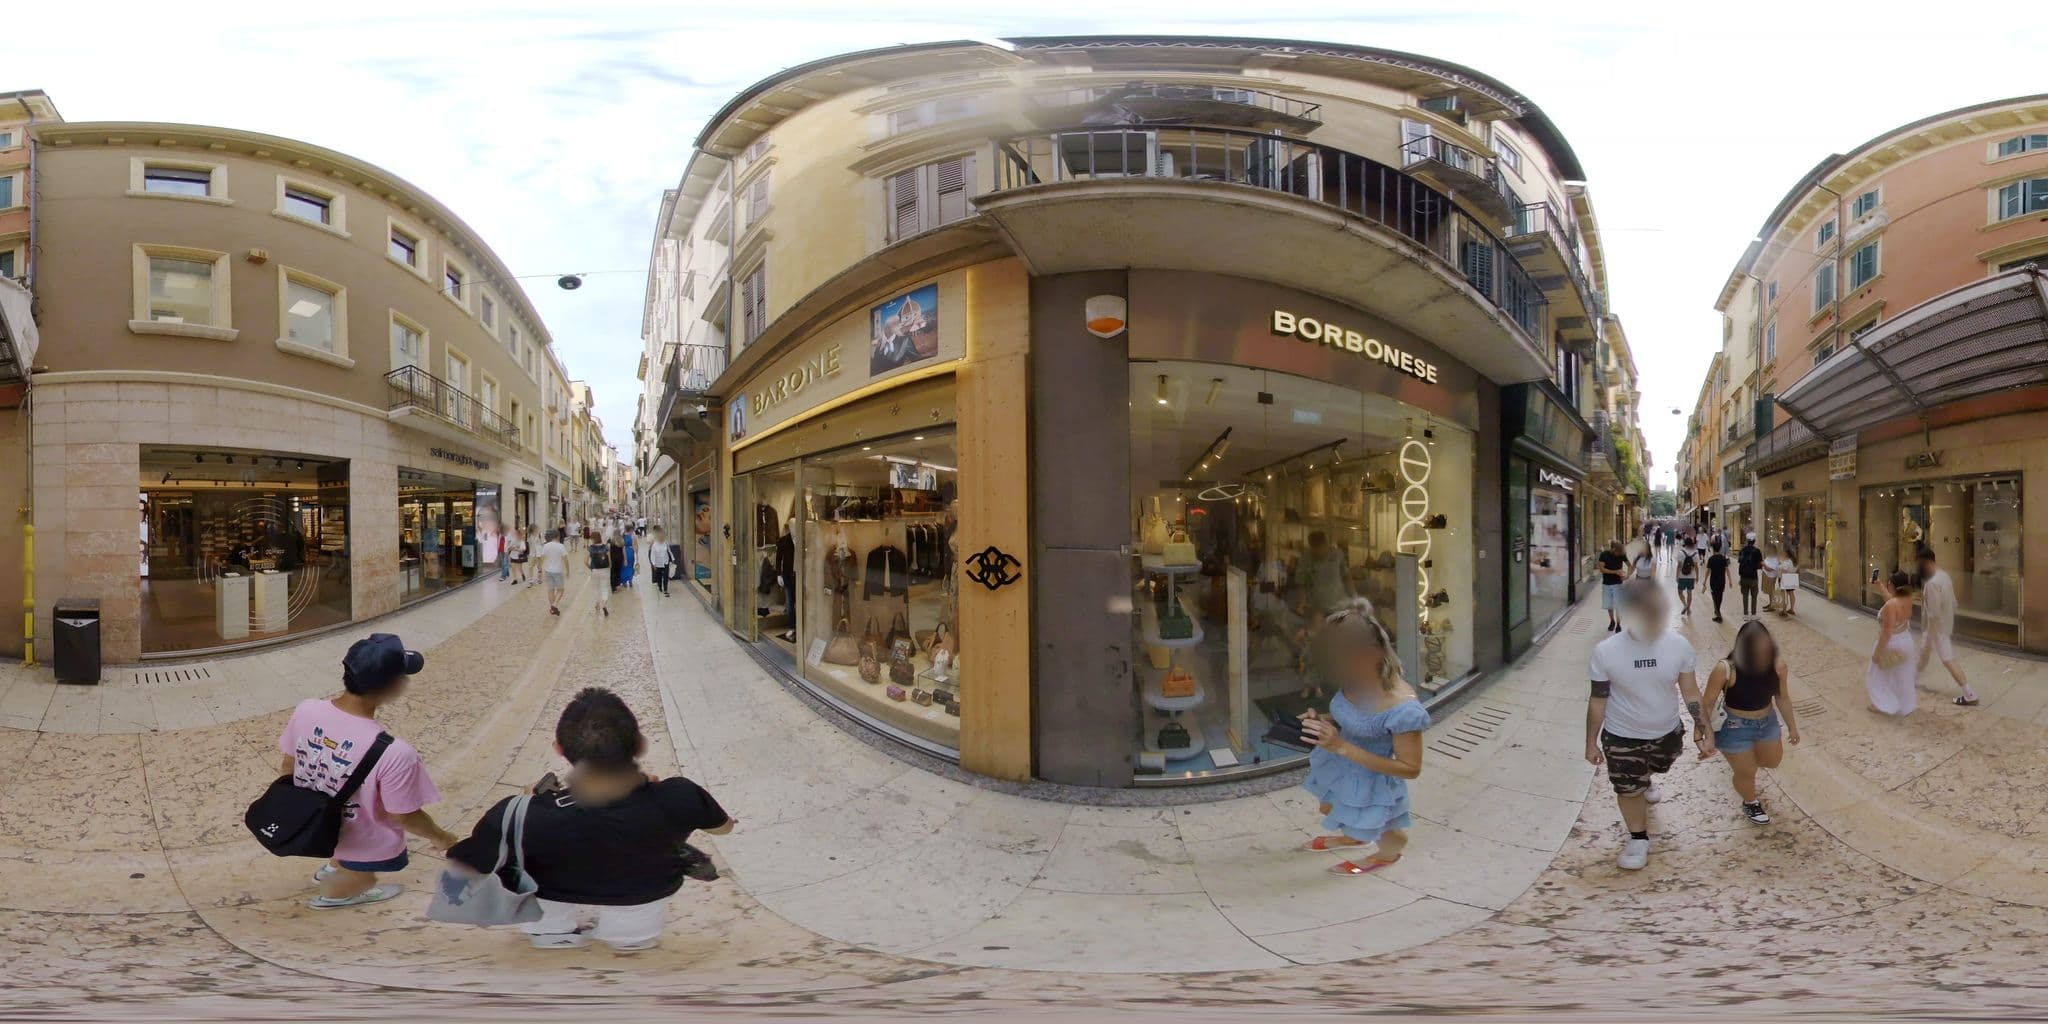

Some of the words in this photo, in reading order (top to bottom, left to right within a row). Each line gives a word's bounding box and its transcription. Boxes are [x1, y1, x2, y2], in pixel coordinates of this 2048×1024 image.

[752, 344, 843, 418] BARONE
[1272, 309, 1438, 384] BORBONESE
[1540, 468, 1574, 490] MAC
